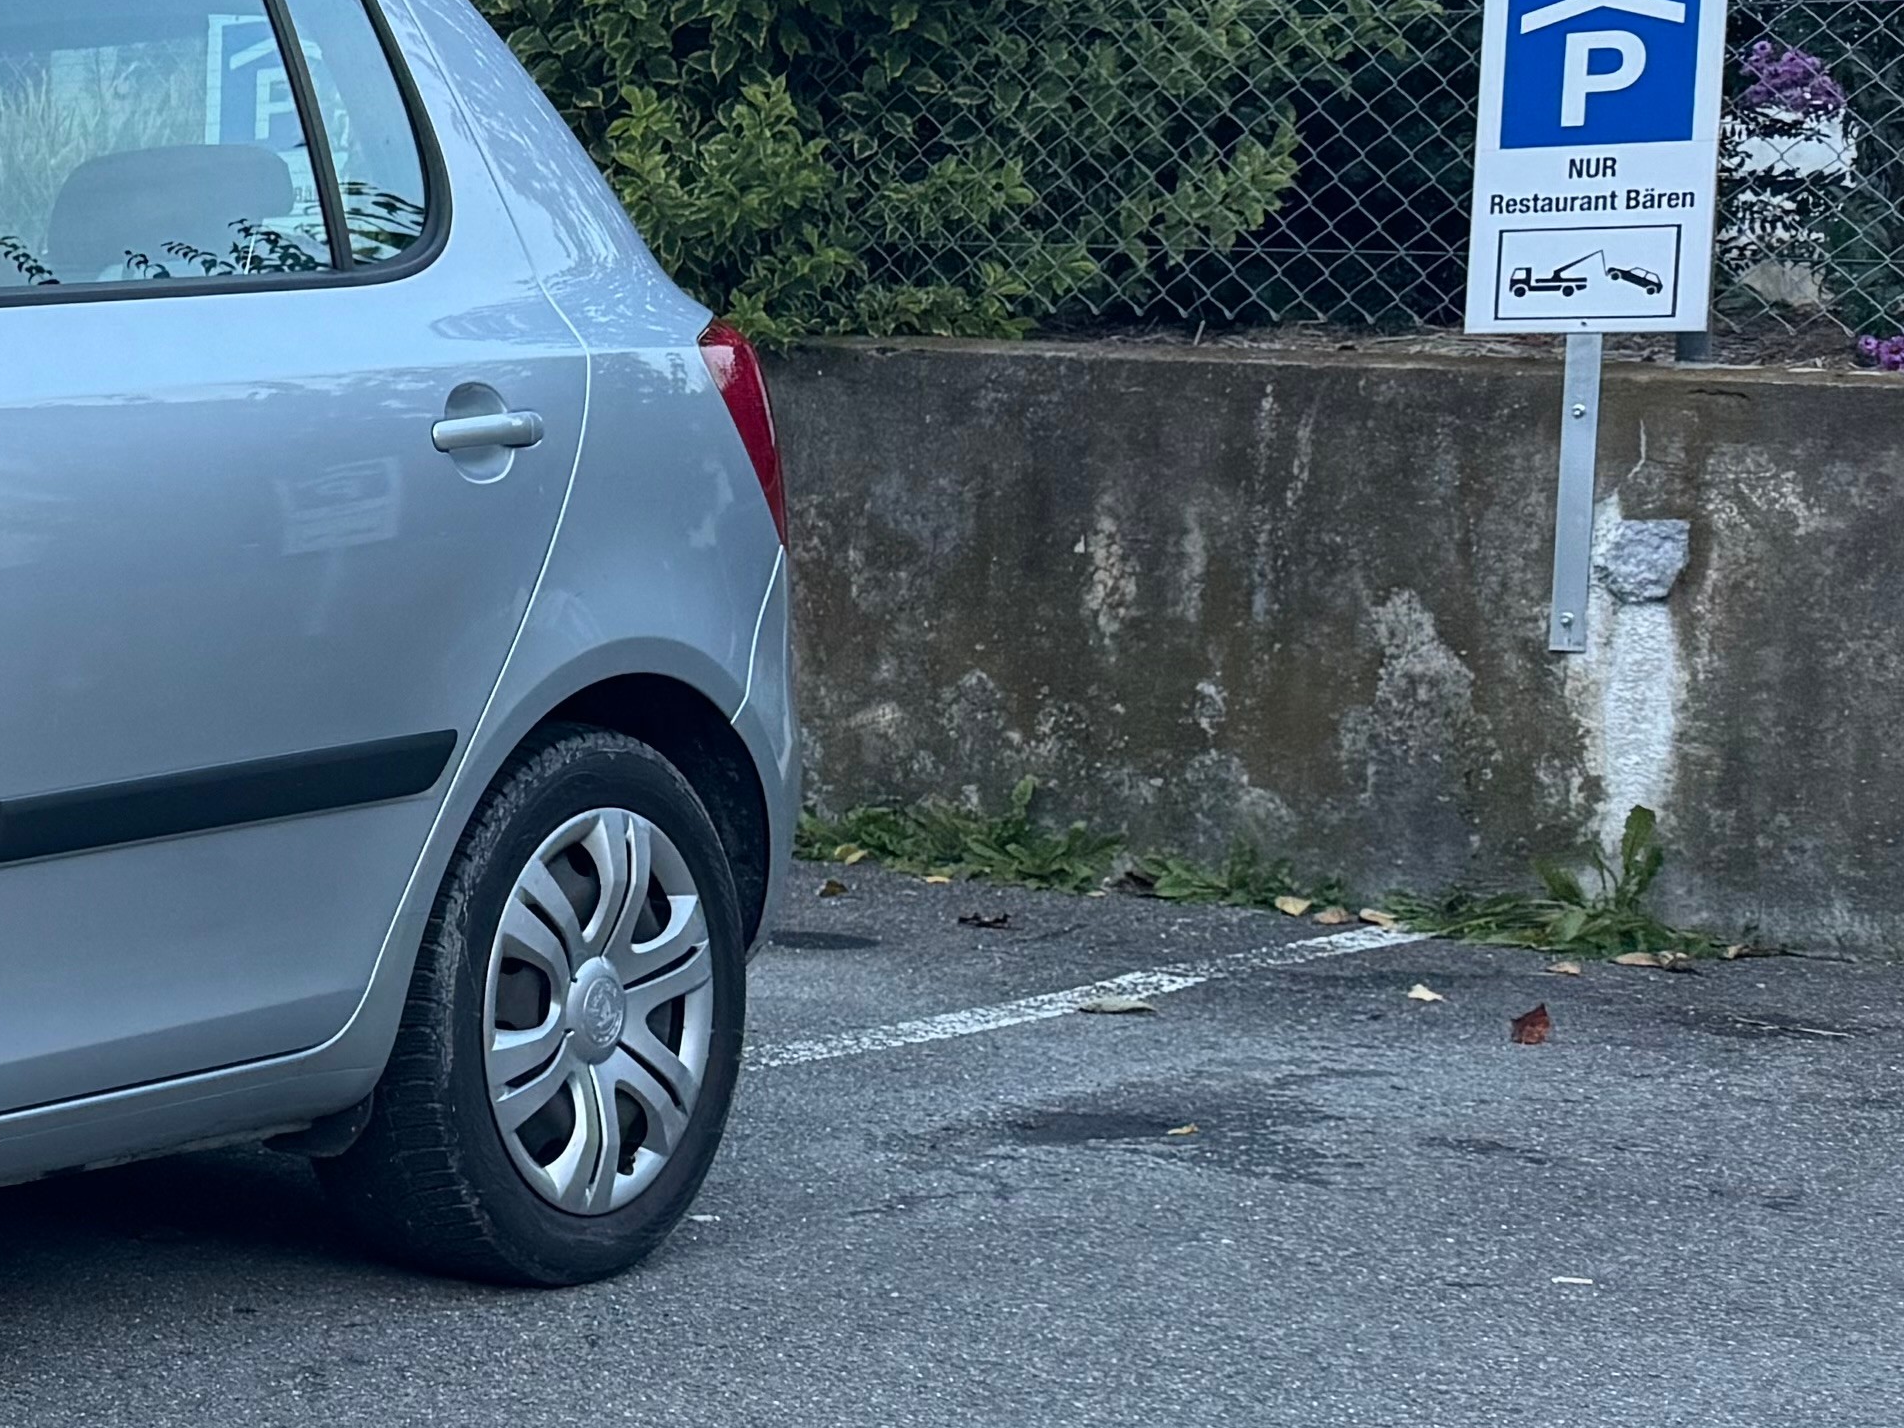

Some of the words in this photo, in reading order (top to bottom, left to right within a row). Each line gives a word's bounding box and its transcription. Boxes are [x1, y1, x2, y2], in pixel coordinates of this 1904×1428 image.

[1560, 30, 1647, 127] P
[1568, 156, 1617, 180] NUR
[1489, 190, 1618, 215] Restaurant
[1625, 188, 1695, 210] Bären
